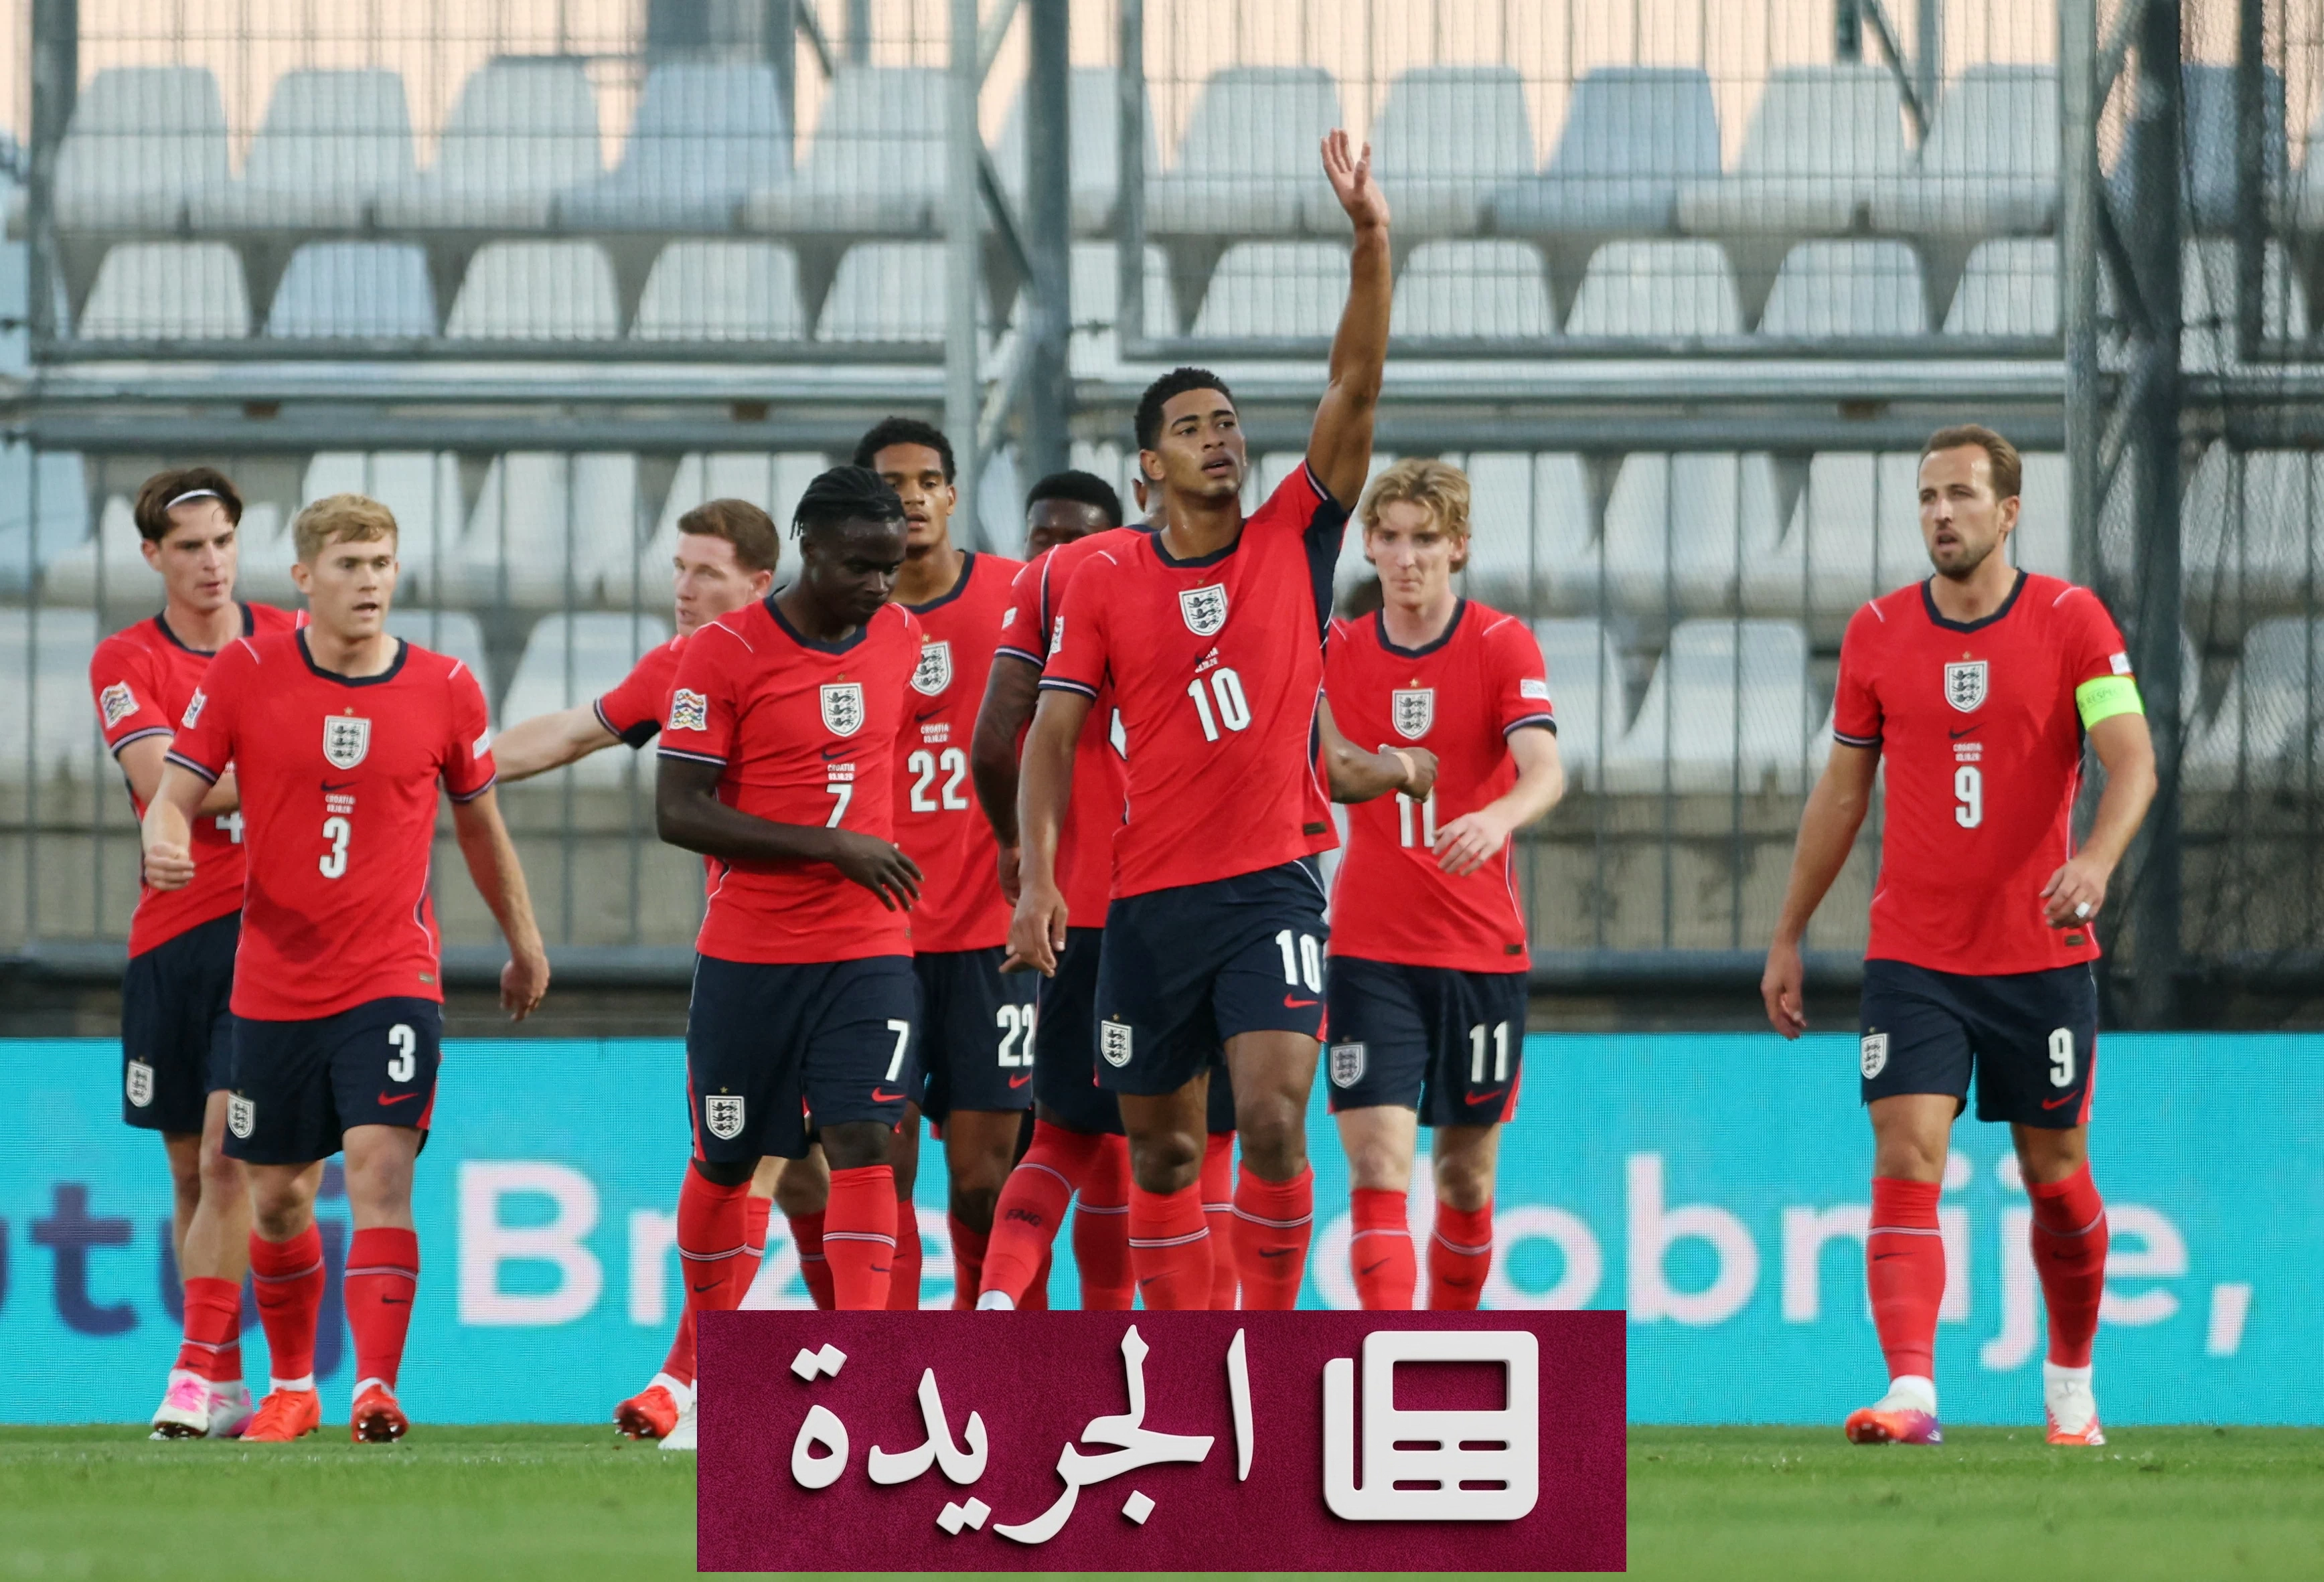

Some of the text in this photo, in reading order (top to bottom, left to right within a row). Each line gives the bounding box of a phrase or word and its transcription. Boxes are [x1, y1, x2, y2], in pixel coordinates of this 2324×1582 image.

[921, 723, 950, 734] CROATIA
[1188, 668, 1251, 741] 10
[828, 763, 856, 772] CROATIA
[909, 748, 967, 811] 22
[1955, 767, 1981, 827] 9
[826, 784, 852, 827] 7
[319, 817, 350, 878] 3
[1276, 930, 1322, 994] 10
[388, 1024, 414, 1082] 3
[886, 1020, 909, 1081] 7
[997, 1004, 1037, 1066] 22
[1470, 1022, 1507, 1082] 11
[2049, 1028, 2074, 1087] 9
